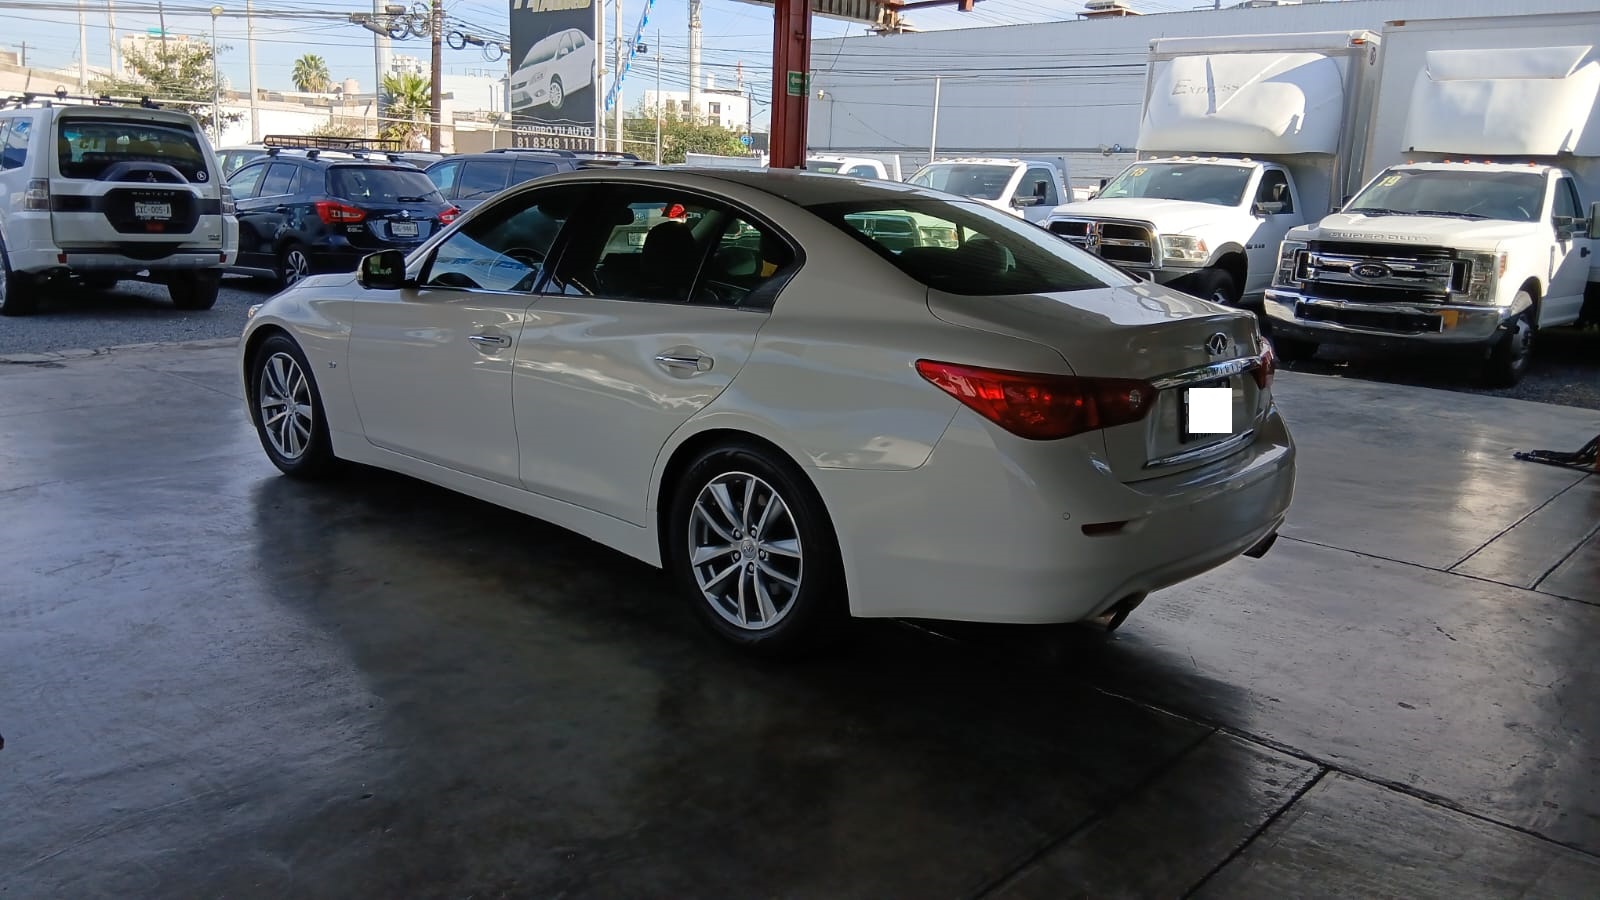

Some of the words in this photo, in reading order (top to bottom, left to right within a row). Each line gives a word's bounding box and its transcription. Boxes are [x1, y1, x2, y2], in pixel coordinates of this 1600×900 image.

[517, 126, 553, 136] COMPRO
[554, 126, 566, 136] TU
[567, 127, 592, 137] AUTO
[517, 137, 530, 148] 81
[533, 137, 560, 149] 8348
[563, 138, 591, 150] 1111
[1375, 175, 1402, 187] 19
[1328, 231, 1385, 241] SUPER
[1387, 234, 1430, 242] DUTY
